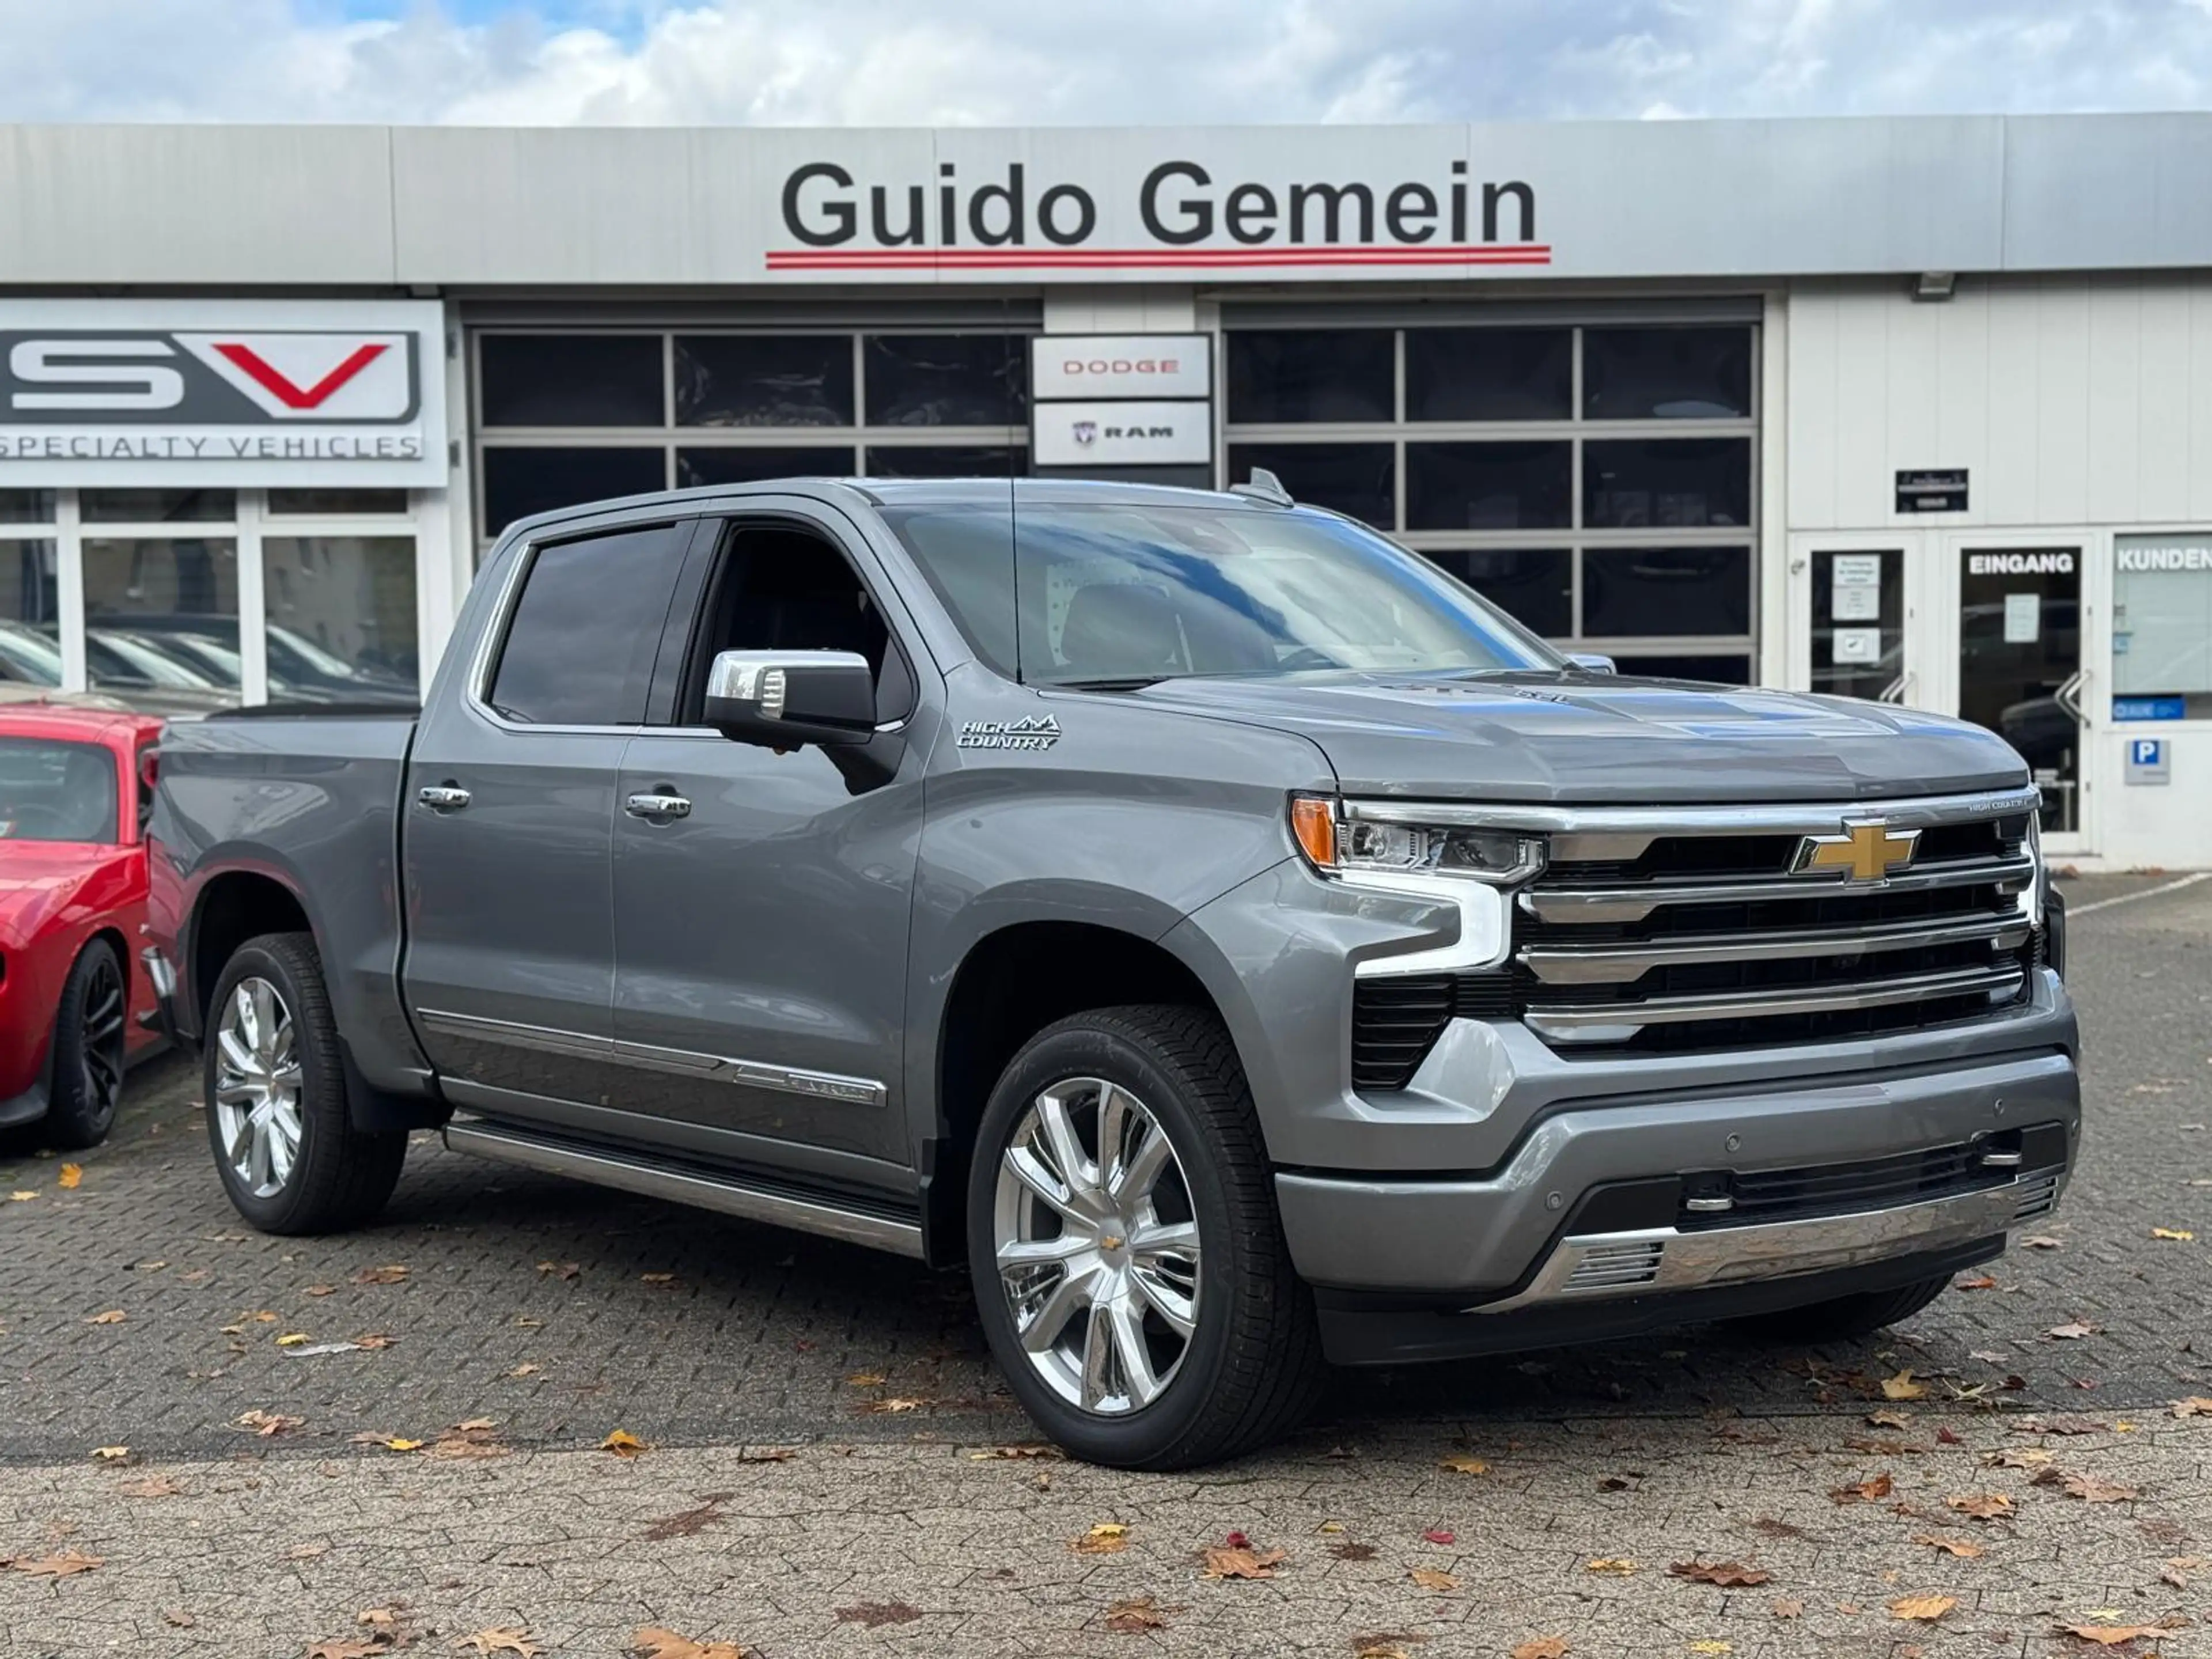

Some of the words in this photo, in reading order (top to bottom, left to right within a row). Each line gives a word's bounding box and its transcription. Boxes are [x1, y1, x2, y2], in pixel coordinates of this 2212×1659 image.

[782, 162, 1097, 247] Guido
[1140, 161, 1535, 245] Gemein
[1063, 361, 1179, 374] DODGE
[1104, 427, 1173, 438] RAM
[227, 436, 418, 459] VEHICLES
[1969, 553, 2074, 574] EINGANG
[2118, 548, 2212, 570] KUNDEN
[962, 721, 1010, 736] HIGH
[957, 734, 1059, 751] COUNTRY
[2138, 741, 2156, 763] P
